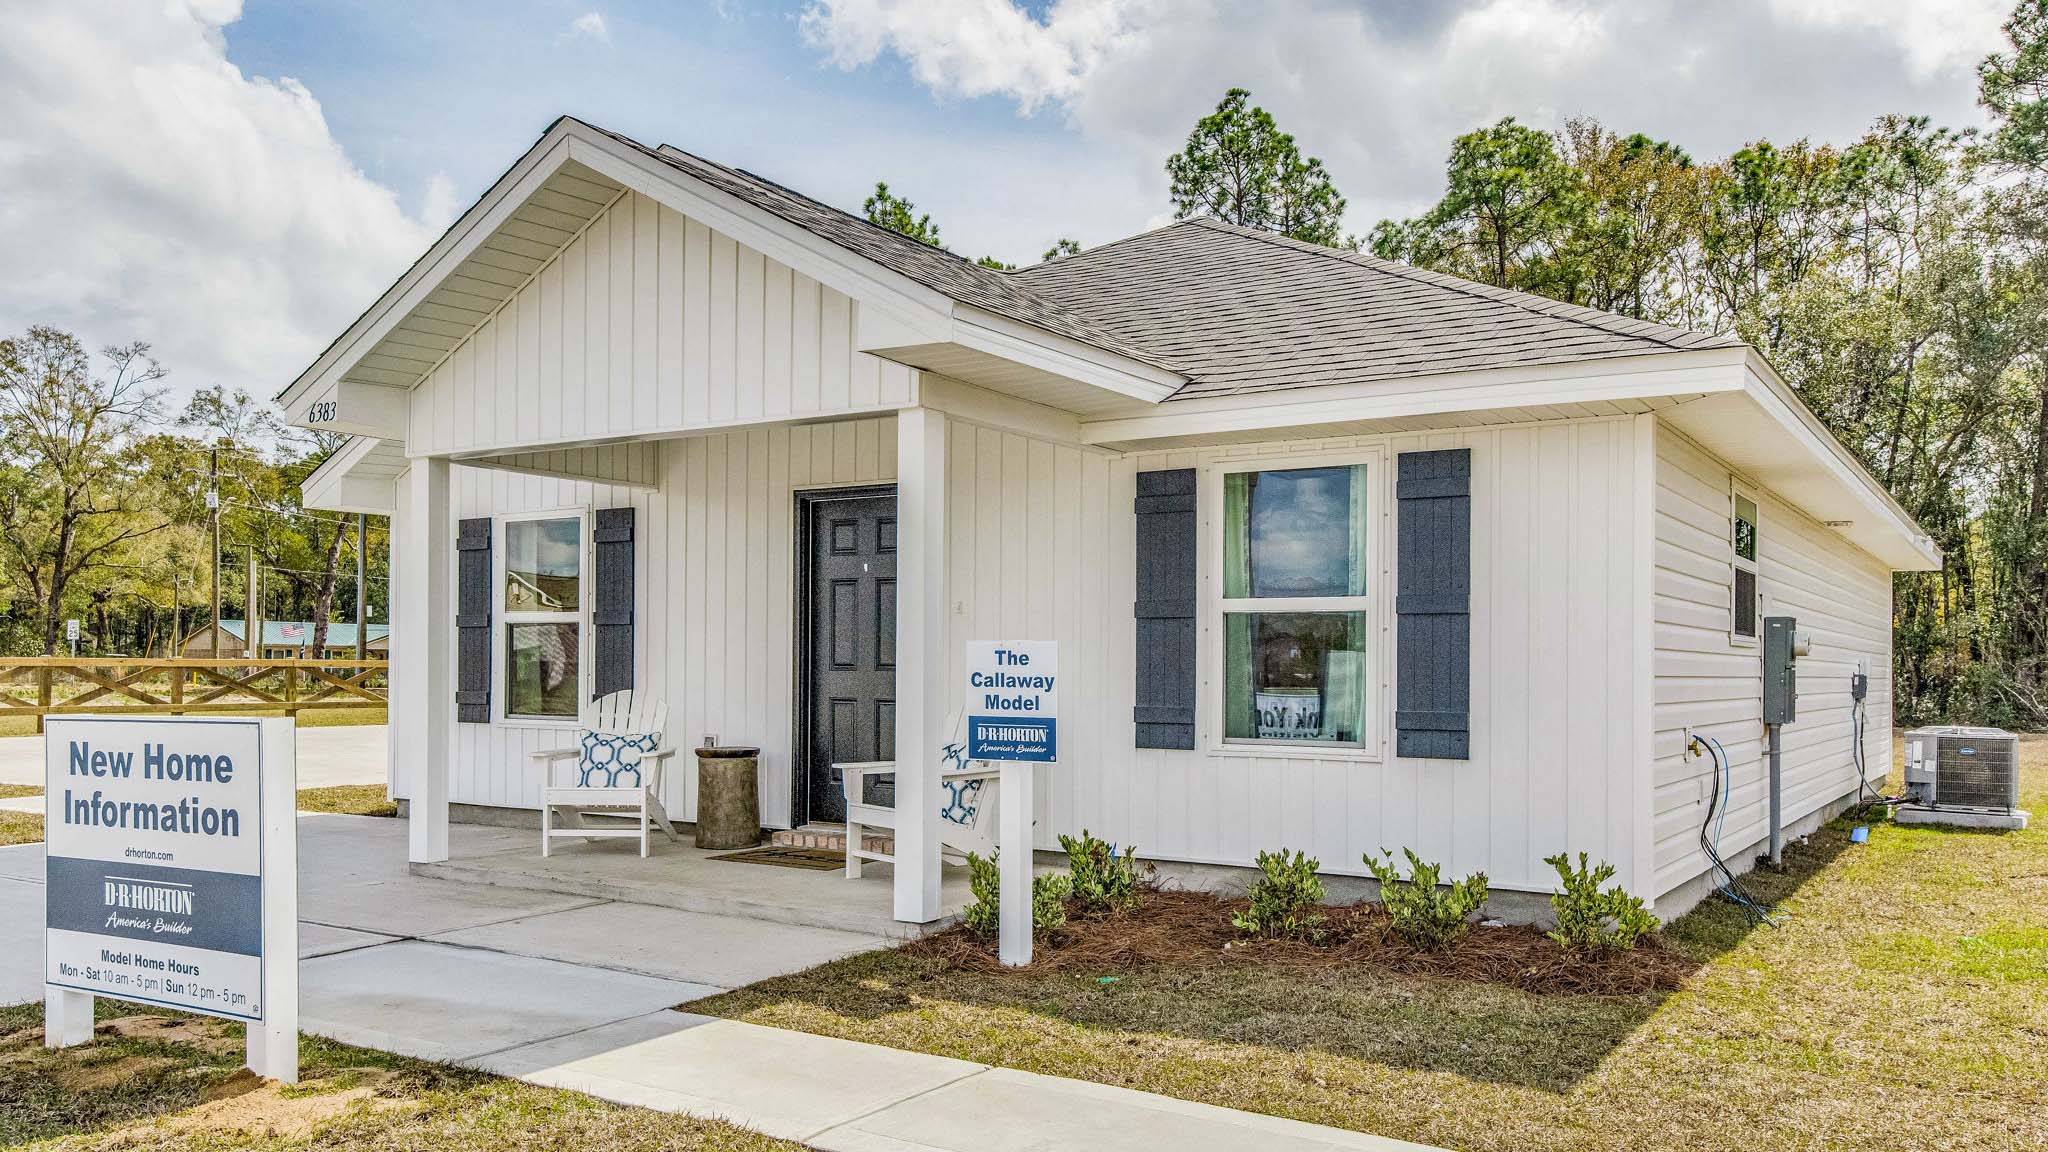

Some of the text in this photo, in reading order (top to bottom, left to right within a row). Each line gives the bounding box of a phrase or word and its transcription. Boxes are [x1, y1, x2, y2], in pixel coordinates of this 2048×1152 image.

[309, 402, 336, 423] 6383
[69, 629, 78, 638] 25
[995, 650, 1030, 666] The
[971, 672, 1055, 693] Callaway
[985, 694, 1040, 711] Model
[977, 743, 1047, 754] America's Builder
[70, 741, 234, 784] New Home
[65, 789, 240, 837] Information
[125, 847, 174, 861] drhorton.com
[105, 911, 192, 935] America's Builder
[101, 949, 200, 976] Model Home Hours
[60, 963, 78, 977] Mon
[86, 967, 100, 981] Sat
[103, 970, 113, 983] 10
[116, 974, 129, 985] am
[137, 974, 143, 987] 5
[145, 979, 158, 991] pm
[166, 979, 184, 995] Sun
[187, 983, 198, 997] 12
[200, 987, 215, 1001] pm
[223, 989, 229, 1002] 5
[232, 993, 246, 1006] pm
